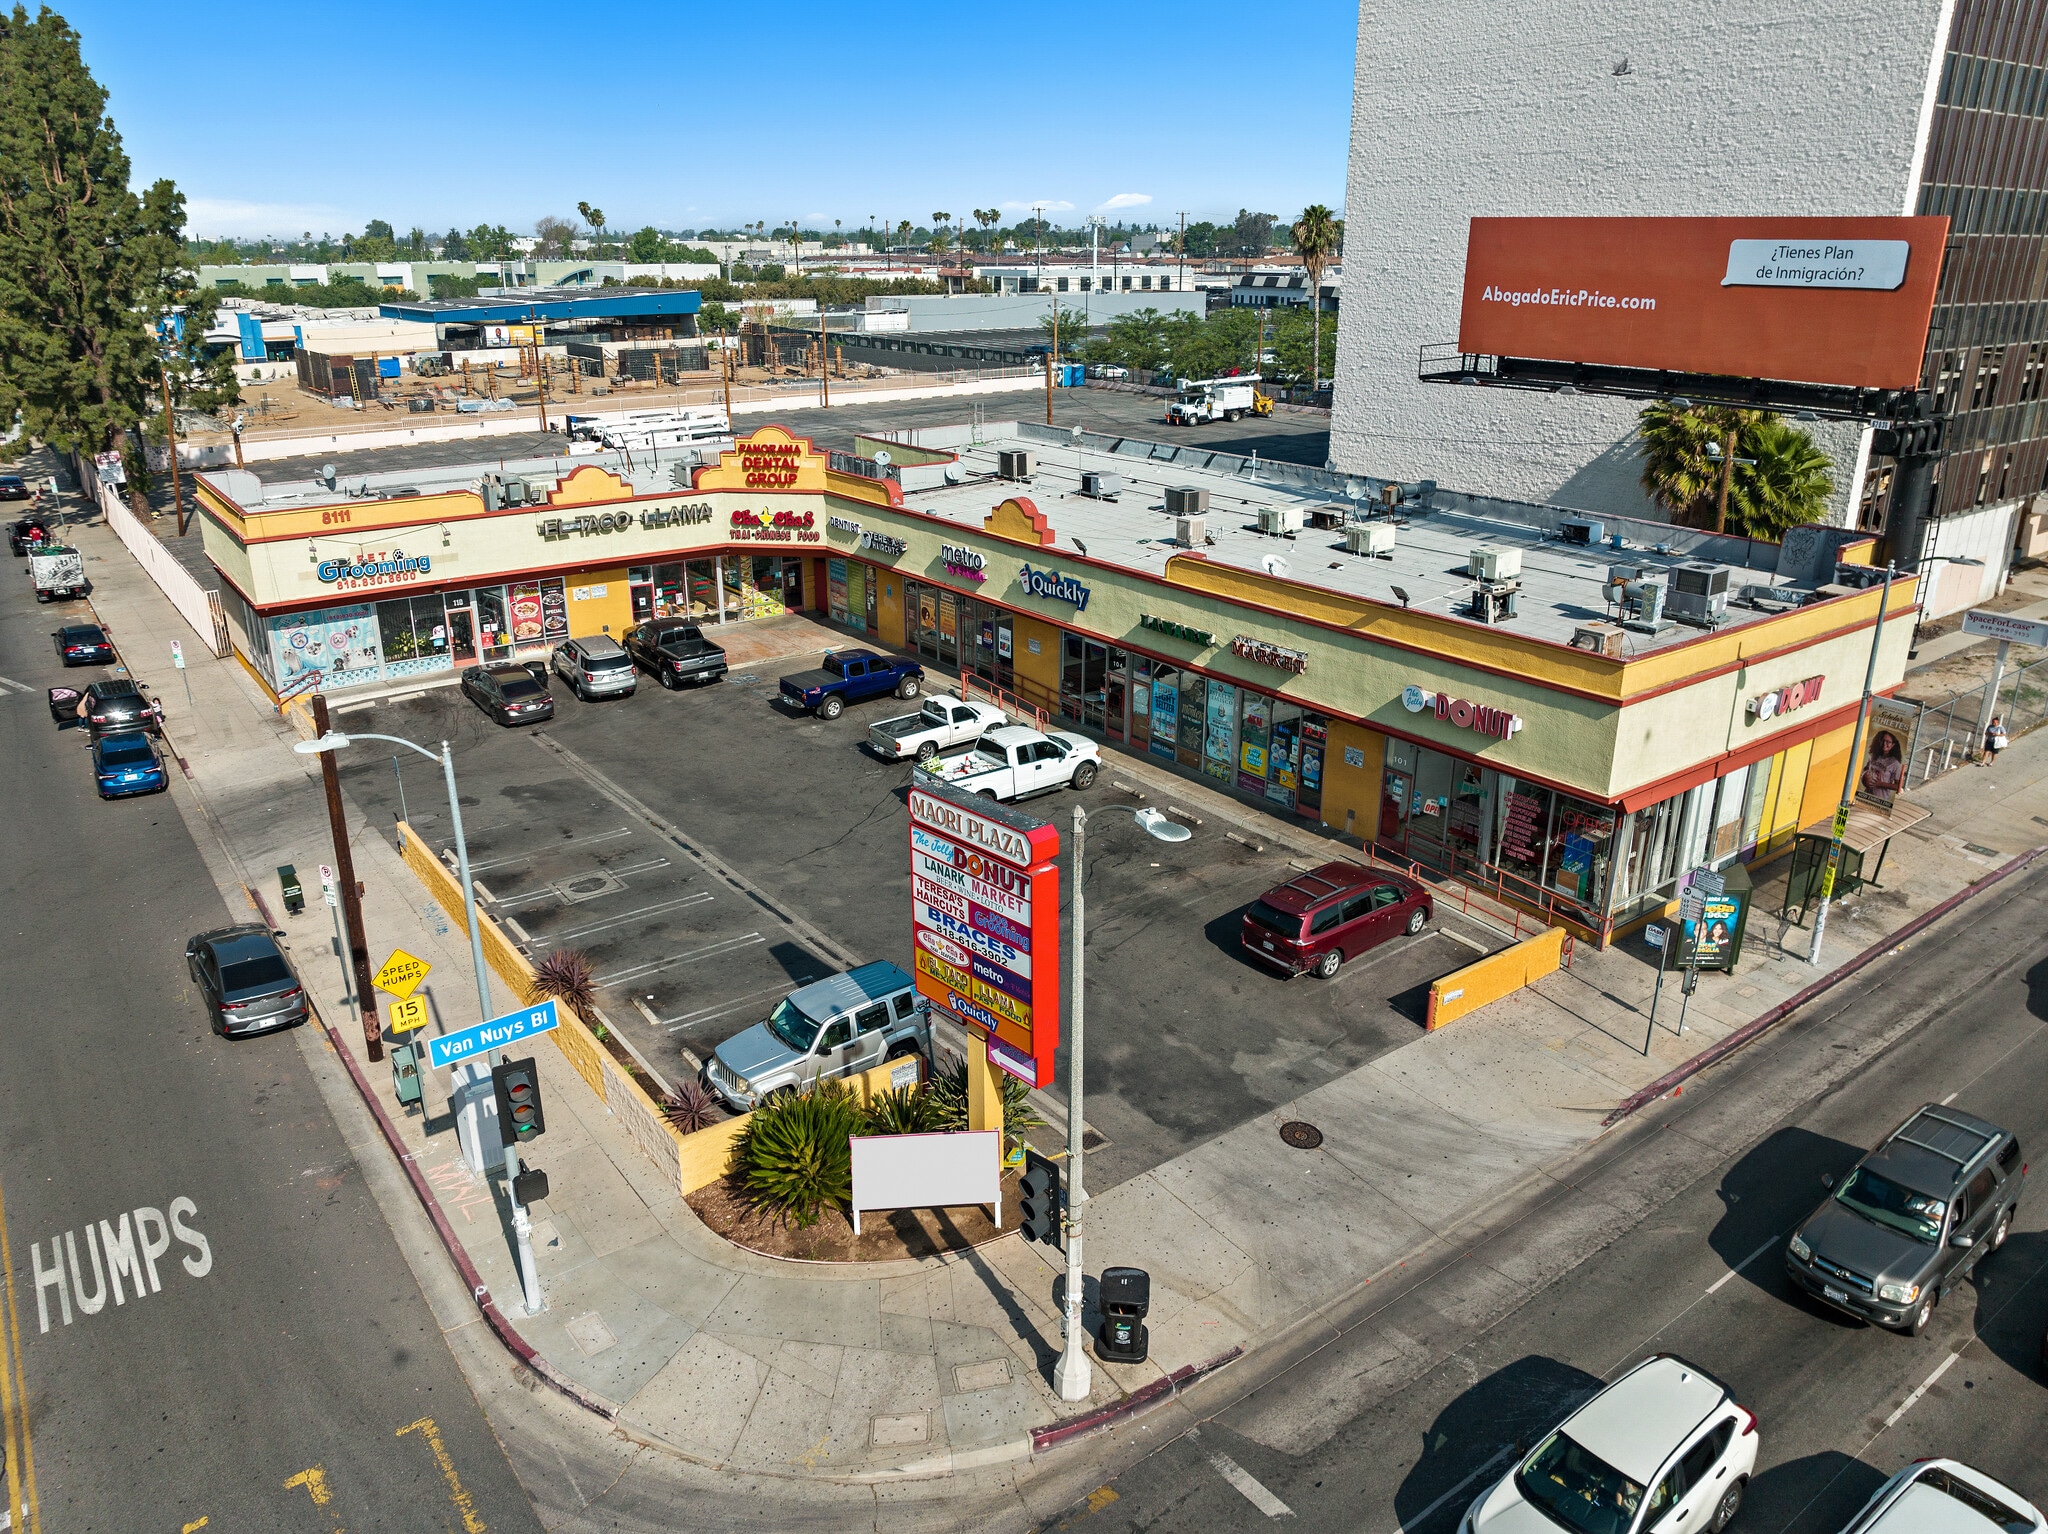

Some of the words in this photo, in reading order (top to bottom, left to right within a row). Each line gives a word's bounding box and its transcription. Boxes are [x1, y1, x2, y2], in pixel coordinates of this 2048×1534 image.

[1771, 246, 1820, 262] ¿Tienes
[1824, 246, 1854, 260] Plan
[1756, 266, 1772, 279] de
[1775, 265, 1865, 283] Inmigración?
[1481, 285, 1656, 311] AbogadoEricPrice.com
[738, 444, 801, 454] PANORAMA
[743, 457, 799, 470] DENTAL
[746, 473, 798, 485] GROUP
[322, 510, 351, 524] 8111
[543, 518, 569, 537] EL
[575, 511, 632, 535] TACO
[642, 503, 712, 527] LLAMA
[830, 516, 860, 535] DENTIST
[730, 530, 750, 540] THAI
[755, 530, 791, 541] CHINESE
[797, 530, 820, 542] FOOD
[870, 531, 903, 548] TEREA'S
[356, 551, 387, 564] PET
[941, 544, 983, 570] metro
[318, 554, 431, 583] Grooming
[337, 571, 417, 590] 818.830.8600
[1032, 574, 1086, 608] Quickly
[1968, 613, 2031, 631] SpaceForLease
[1406, 688, 1419, 698] The
[1406, 697, 1423, 707] Jelly
[1155, 700, 1175, 714] SELTZER
[1434, 692, 1513, 740] DONUT
[1872, 715, 1909, 731] ATHLETES
[1393, 756, 1407, 766] 101
[912, 795, 963, 834] MAORI
[966, 817, 1027, 862] PLAZA
[913, 830, 929, 848] The
[931, 839, 954, 862] Jelly
[954, 846, 1029, 898] DONUT
[917, 877, 963, 908] TERESA'S
[924, 857, 965, 887] LANARK
[971, 879, 1023, 914] MARKET
[936, 876, 953, 890] BEER
[958, 885, 976, 900] WINE
[980, 895, 1004, 913] LOTTO
[916, 888, 965, 920] HAIRCUTS
[928, 906, 1017, 961] BRACES
[974, 911, 1030, 952] Grooming
[936, 924, 1008, 967] 818-616-3902
[382, 961, 420, 978] SPEED
[382, 970, 422, 987] HUMPS
[973, 960, 1004, 984] metro
[928, 957, 940, 971] EL
[944, 965, 968, 987] TACO
[980, 983, 1017, 1013] LLAMA
[929, 969, 965, 993] MEXICAN
[973, 993, 995, 1008] FAST
[999, 1007, 1022, 1023] FOOD
[397, 1001, 418, 1019] 15
[958, 998, 998, 1029] Quickly
[400, 1016, 420, 1027] MPH
[440, 1038, 473, 1058] Van
[479, 1021, 524, 1045] Nuys
[531, 1010, 548, 1027] Bl
[31, 1196, 213, 1335] HUMPS
